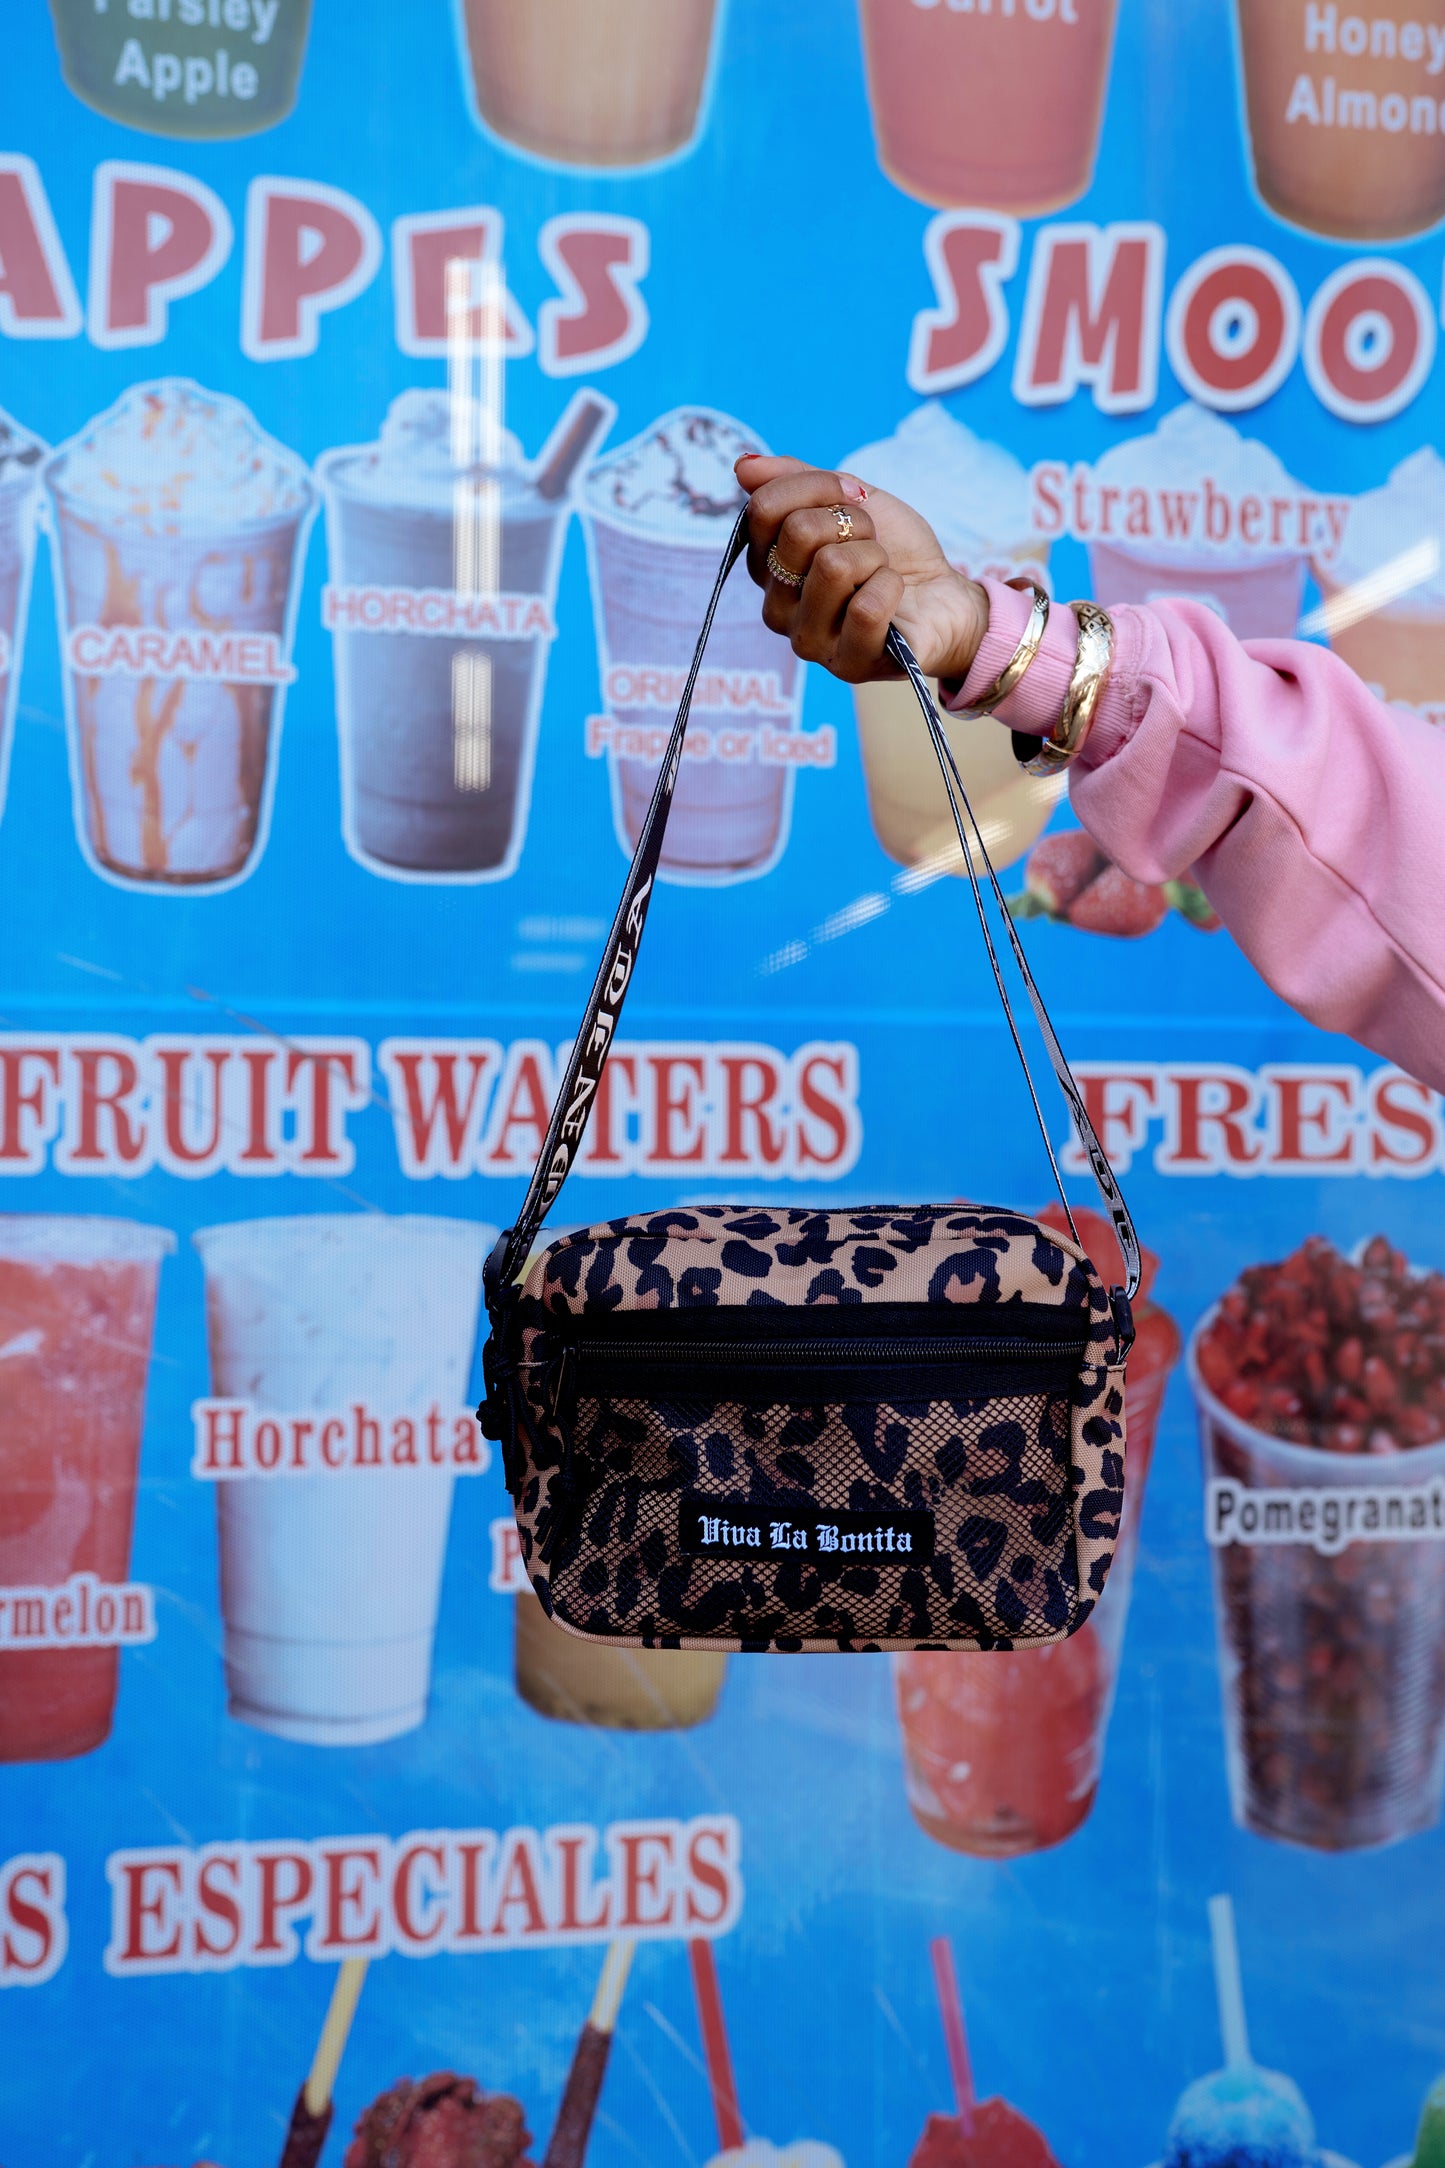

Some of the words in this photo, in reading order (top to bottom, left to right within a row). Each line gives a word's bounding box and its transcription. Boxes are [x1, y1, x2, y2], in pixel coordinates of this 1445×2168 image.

[93, 0, 279, 44] rsley
[1304, 0, 1445, 75] Honey
[114, 38, 258, 104] Apple
[1285, 74, 1445, 135] Almon
[1033, 462, 1351, 562] Strawberry
[326, 589, 552, 638] HORCHATA
[70, 629, 291, 683] CARAMEL
[717, 732, 751, 760] or
[0, 1045, 360, 1166] FRUIT
[392, 1048, 850, 1169] WATERS
[200, 1404, 485, 1470] Horchata
[698, 1515, 762, 1547] Viva
[769, 1522, 808, 1550] La
[815, 1524, 913, 1552] Bonita
[0, 1584, 145, 1638] melon
[119, 1822, 735, 1962] ESPECIALES
